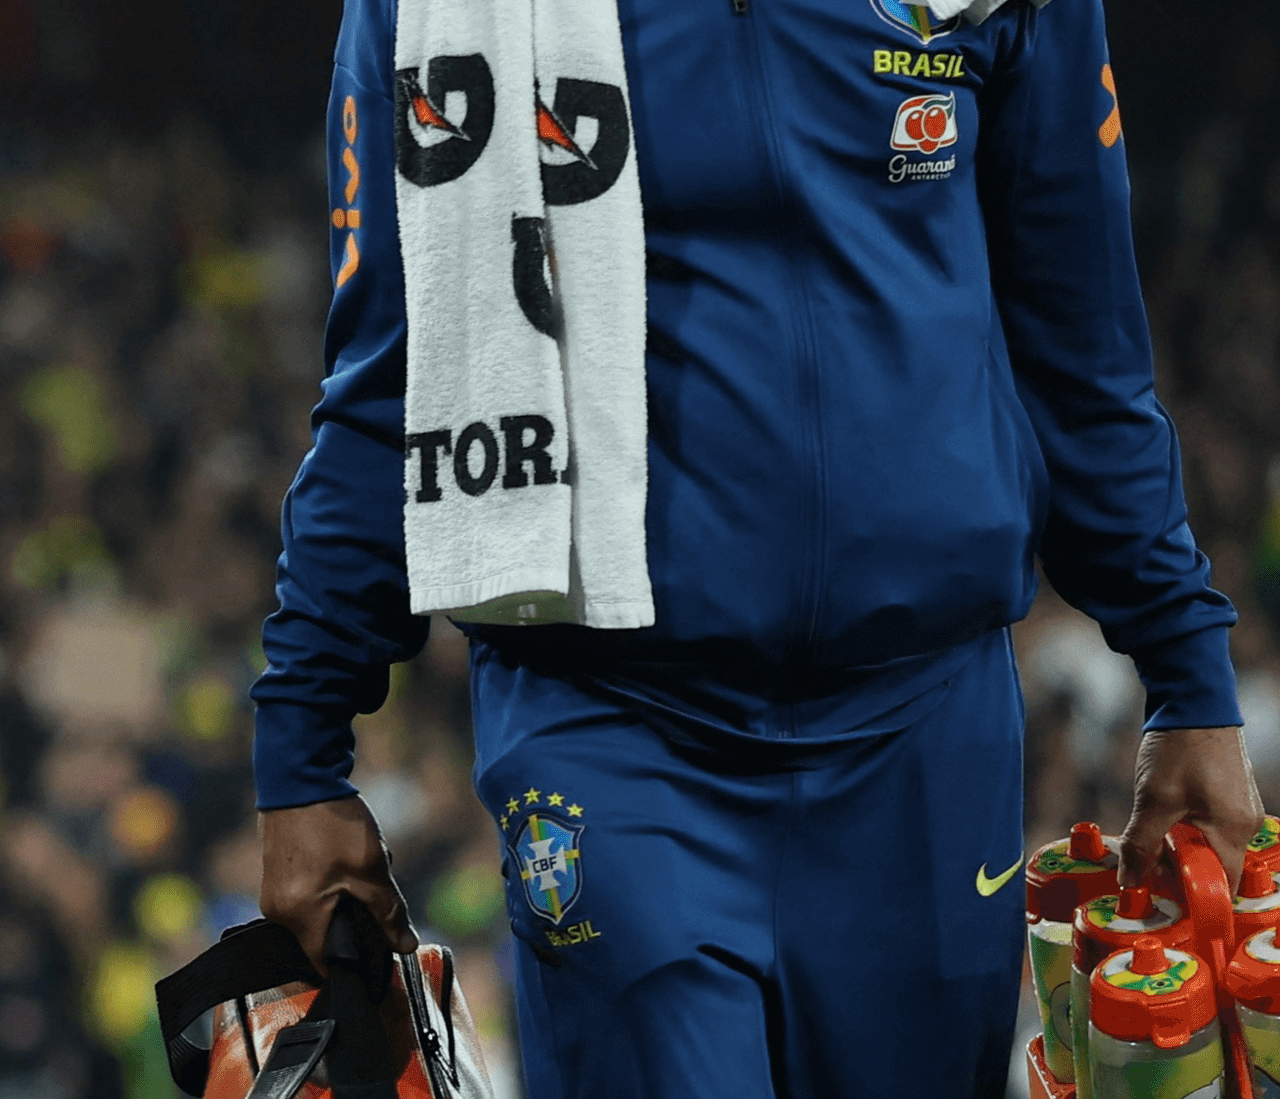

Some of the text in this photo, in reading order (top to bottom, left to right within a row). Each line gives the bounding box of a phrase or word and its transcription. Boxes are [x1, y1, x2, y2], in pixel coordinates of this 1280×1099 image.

[873, 50, 965, 78] BRASIL
[331, 95, 361, 288] vivo
[406, 414, 578, 504] TOR
[532, 856, 557, 873] CBF
